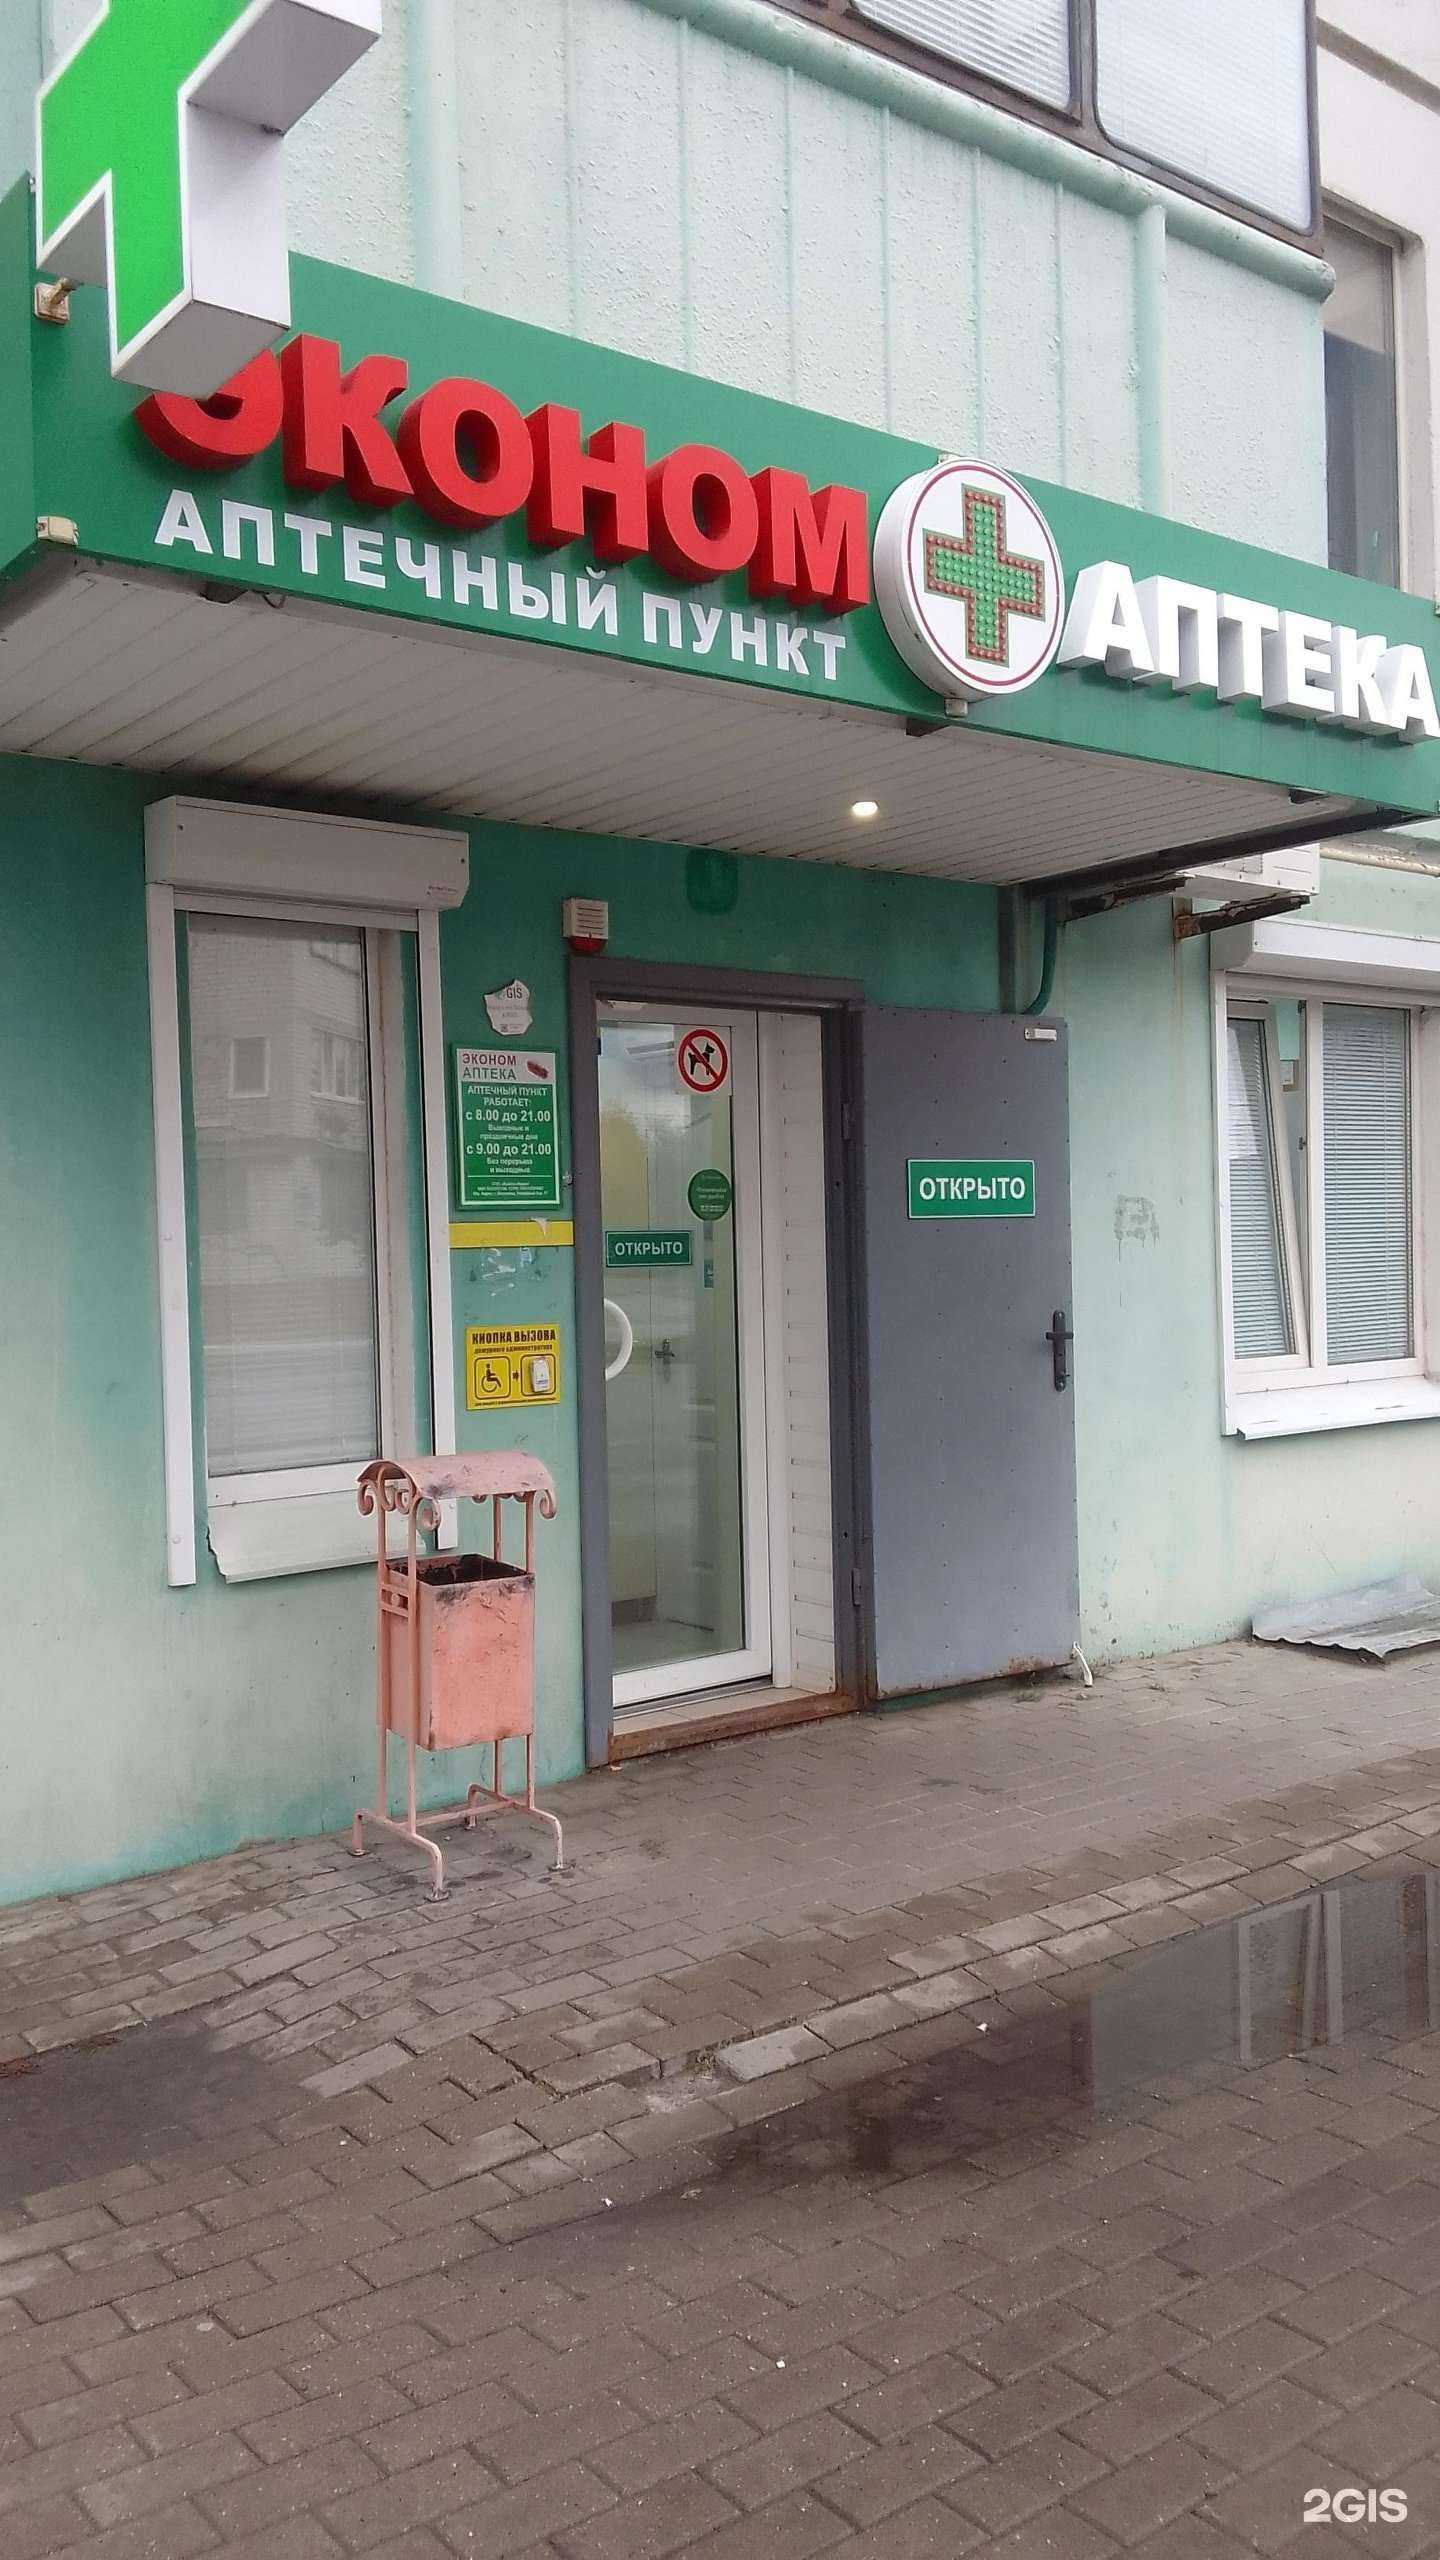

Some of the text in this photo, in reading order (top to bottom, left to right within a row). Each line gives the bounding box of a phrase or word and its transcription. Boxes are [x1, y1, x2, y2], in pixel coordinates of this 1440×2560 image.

[154, 489, 847, 681] АПТЕЧНЫЙ ПУНКТ
[1056, 559, 1440, 745] АПТЕКА
[462, 1053, 516, 1066] ЭКОНОМ
[462, 1067, 517, 1080] АПТЕКА
[467, 1085, 548, 1096] АПТЕЧНЫЙ ПУНКТ
[465, 1109, 551, 1123] с 8.00 до 21.00
[466, 1143, 552, 1157] с 9.00 до 21.00
[918, 1176, 1027, 1201] ОТКРЫТО
[614, 1241, 684, 1256] ОТКРЫТО
[472, 1329, 556, 1345] КНОПКА ВЫЗОВА
